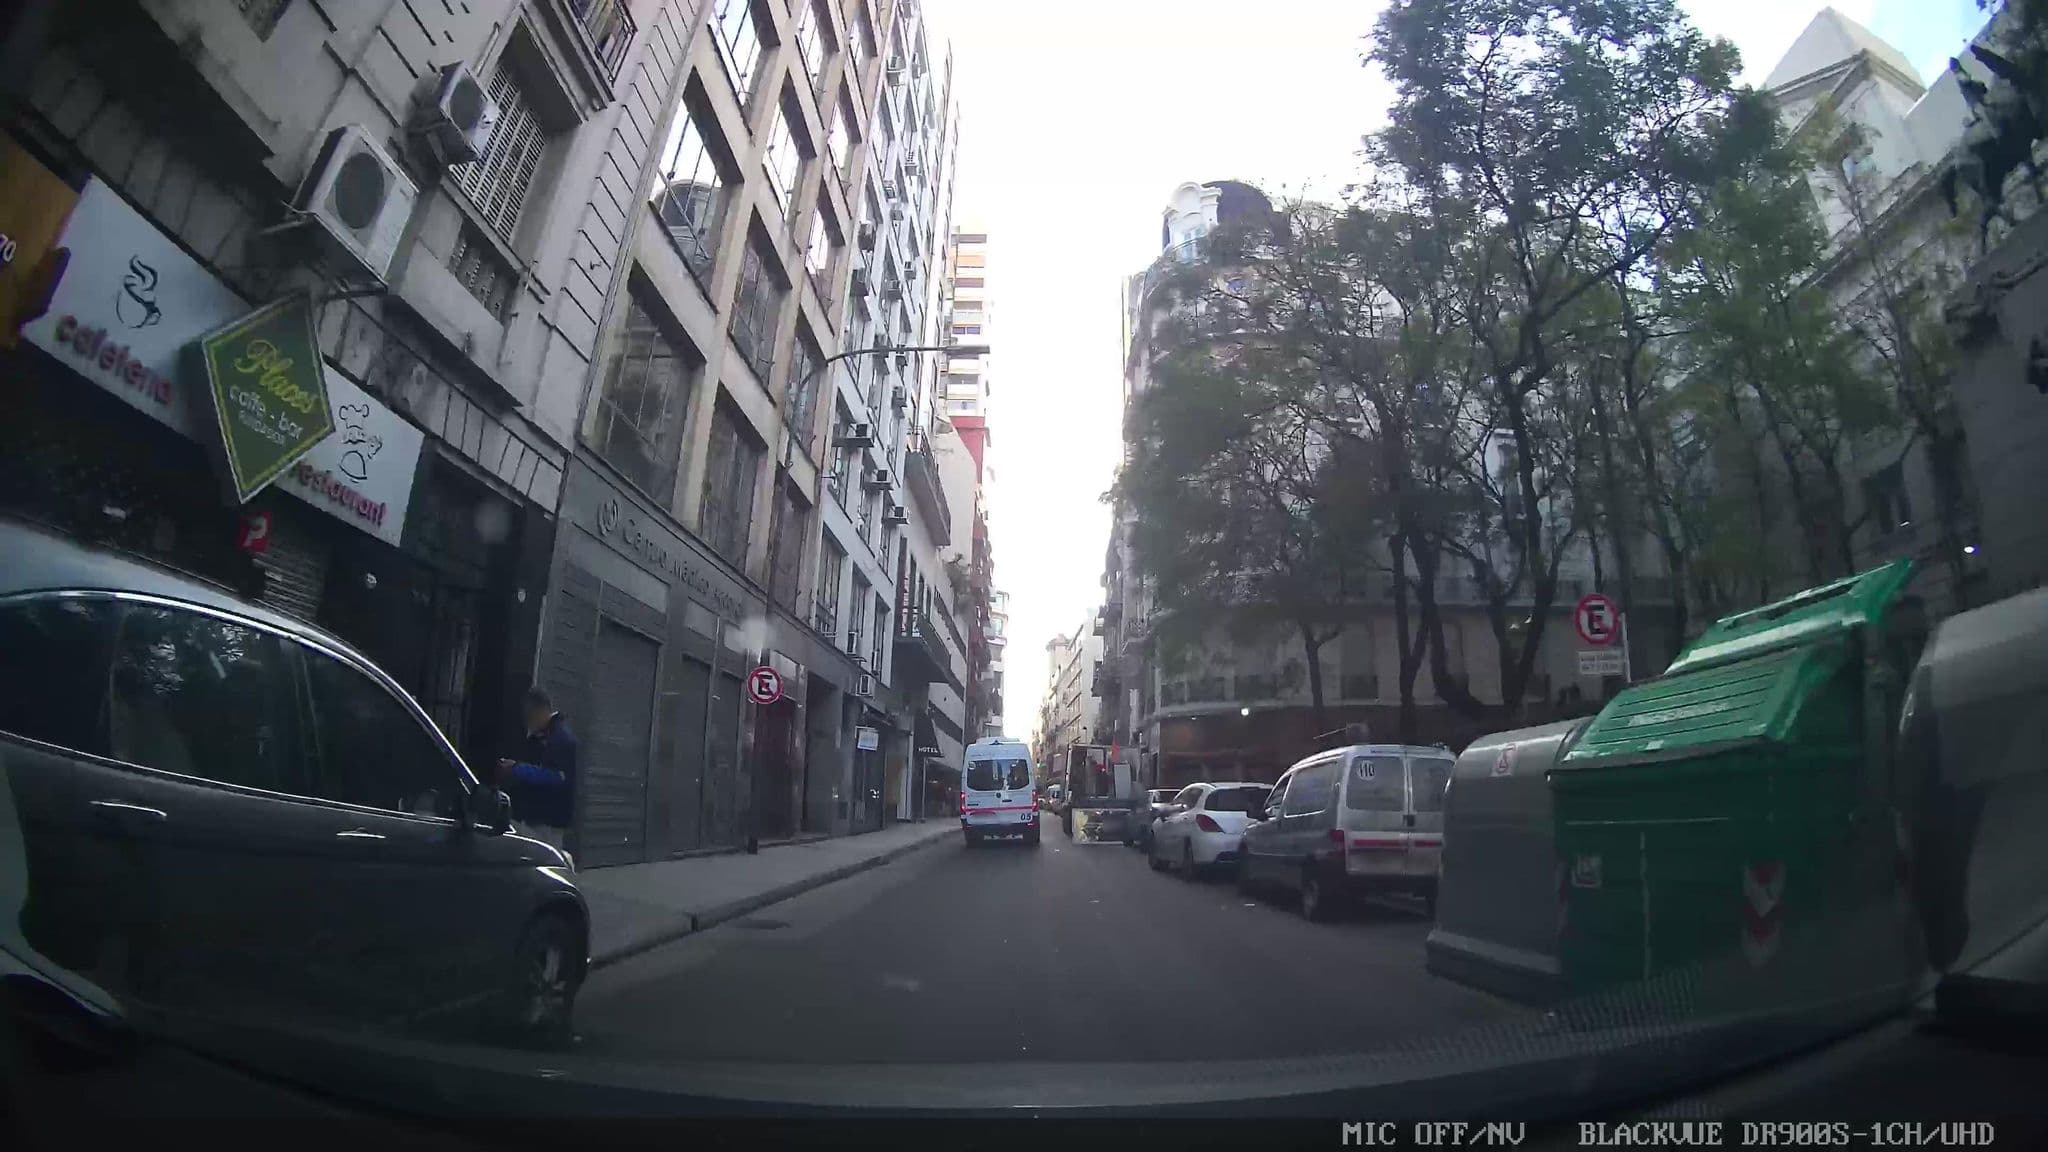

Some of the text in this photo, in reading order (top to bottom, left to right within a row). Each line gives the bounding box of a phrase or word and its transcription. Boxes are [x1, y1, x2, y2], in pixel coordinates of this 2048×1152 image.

[1588, 604, 1605, 635] E
[756, 674, 774, 696] E
[918, 746, 939, 754] HOTEL
